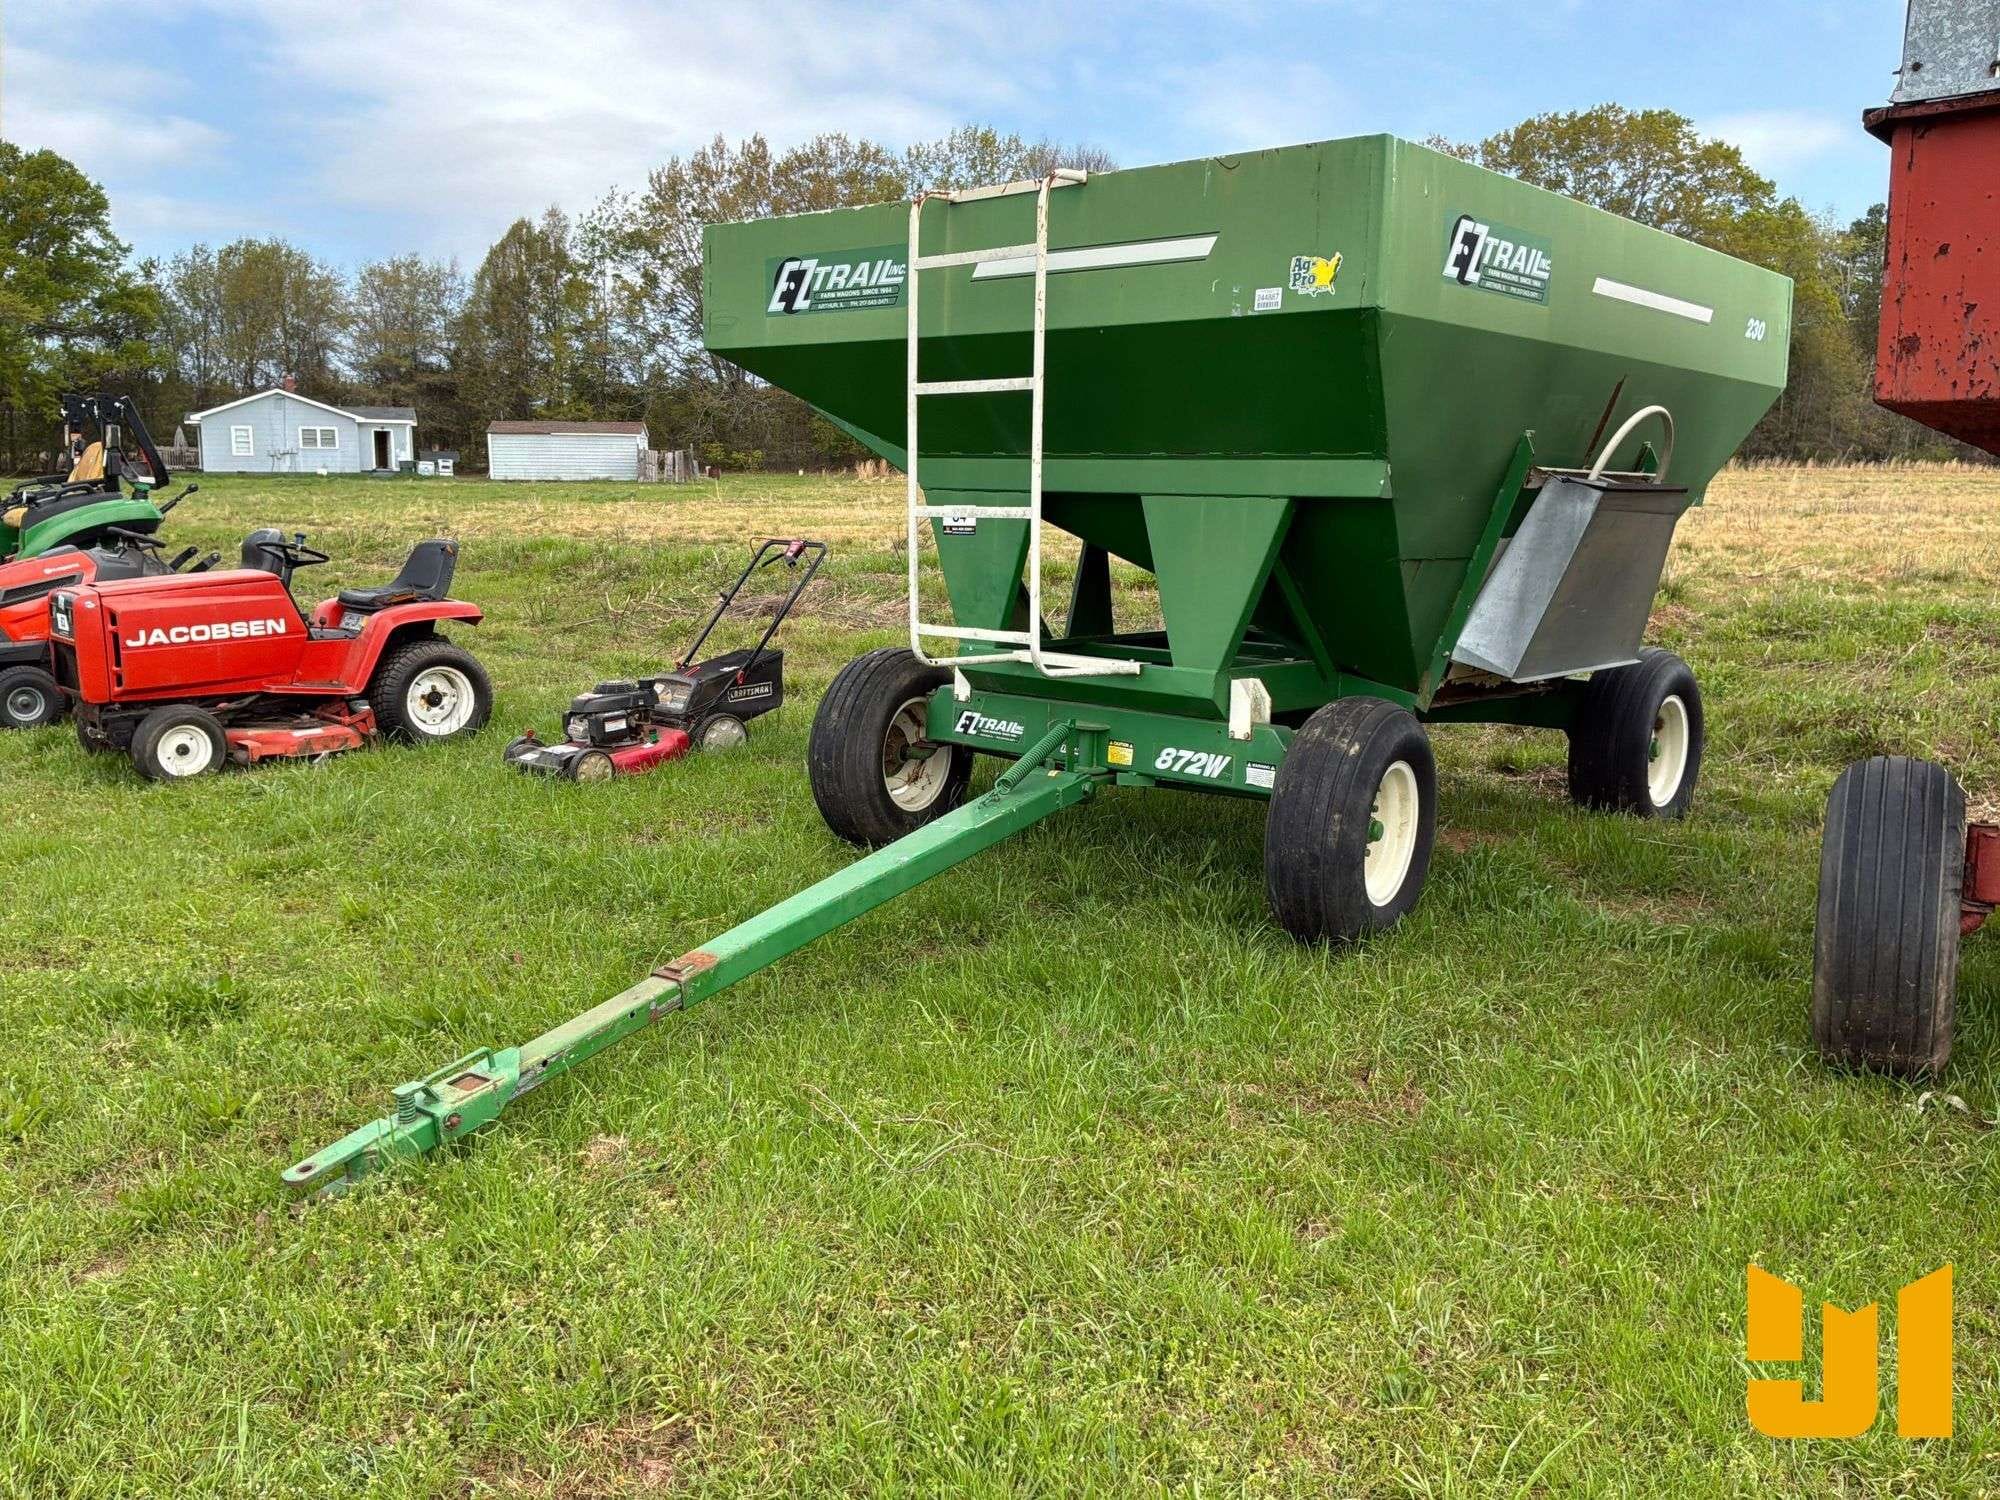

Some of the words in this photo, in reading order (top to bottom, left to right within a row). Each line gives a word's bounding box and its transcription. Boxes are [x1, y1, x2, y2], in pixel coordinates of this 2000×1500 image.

[1292, 257, 1311, 274] Ag
[1482, 235, 1551, 280] TRAIL
[813, 259, 904, 291] TRAIL
[1292, 272, 1315, 287] Pro
[1745, 317, 1766, 341] 230
[125, 618, 286, 647] JACOBSEN
[730, 685, 769, 699] CRAFTSMAN
[978, 717, 1024, 735] TRAIL
[1154, 747, 1232, 778] 872W
